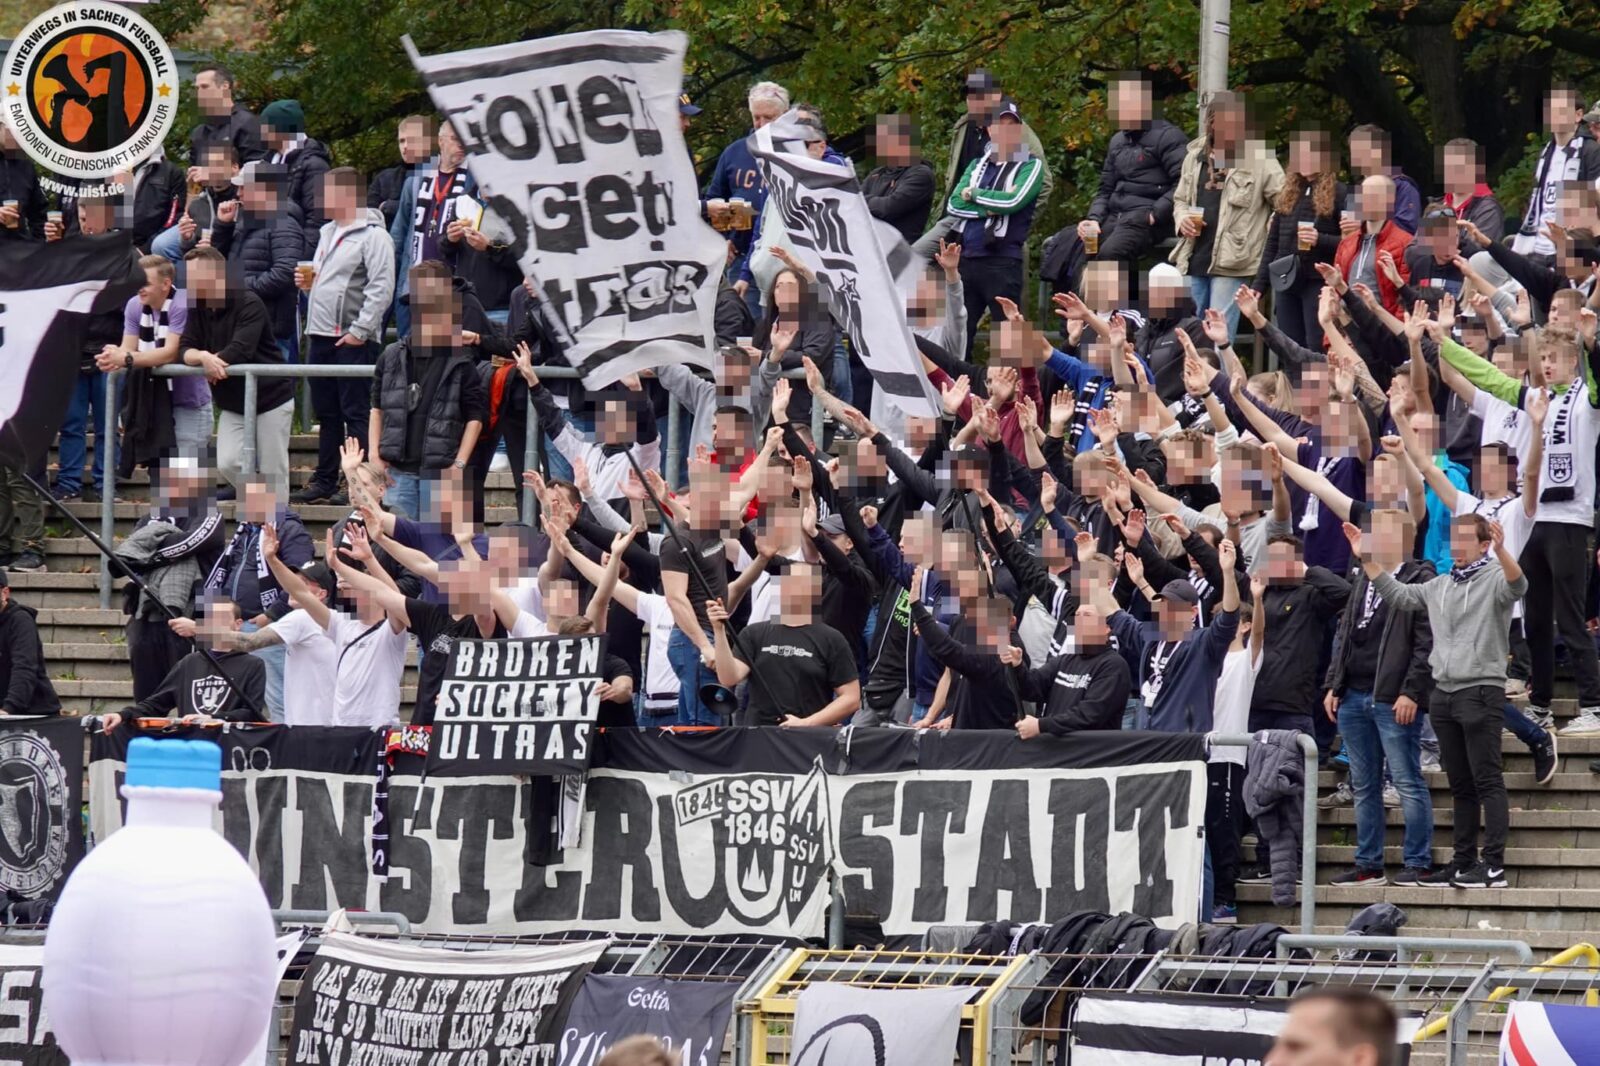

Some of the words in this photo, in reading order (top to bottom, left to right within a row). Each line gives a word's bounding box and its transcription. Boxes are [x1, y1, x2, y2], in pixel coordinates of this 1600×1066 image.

[455, 636, 600, 677] BROKEN
[445, 680, 596, 718] SOCIETY
[439, 722, 590, 761] ULTRAS
[727, 778, 792, 814] SSV
[724, 812, 786, 846] 1846
[788, 833, 819, 864] SSV
[312, 961, 350, 999] DAS
[346, 969, 387, 1006] ZIEL
[387, 976, 426, 1011] DAS
[423, 979, 458, 1014] IST
[456, 979, 505, 1014] EINE
[342, 1003, 367, 1040] 90
[372, 1006, 444, 1049] MINUTEN
[449, 1014, 494, 1050] LANG
